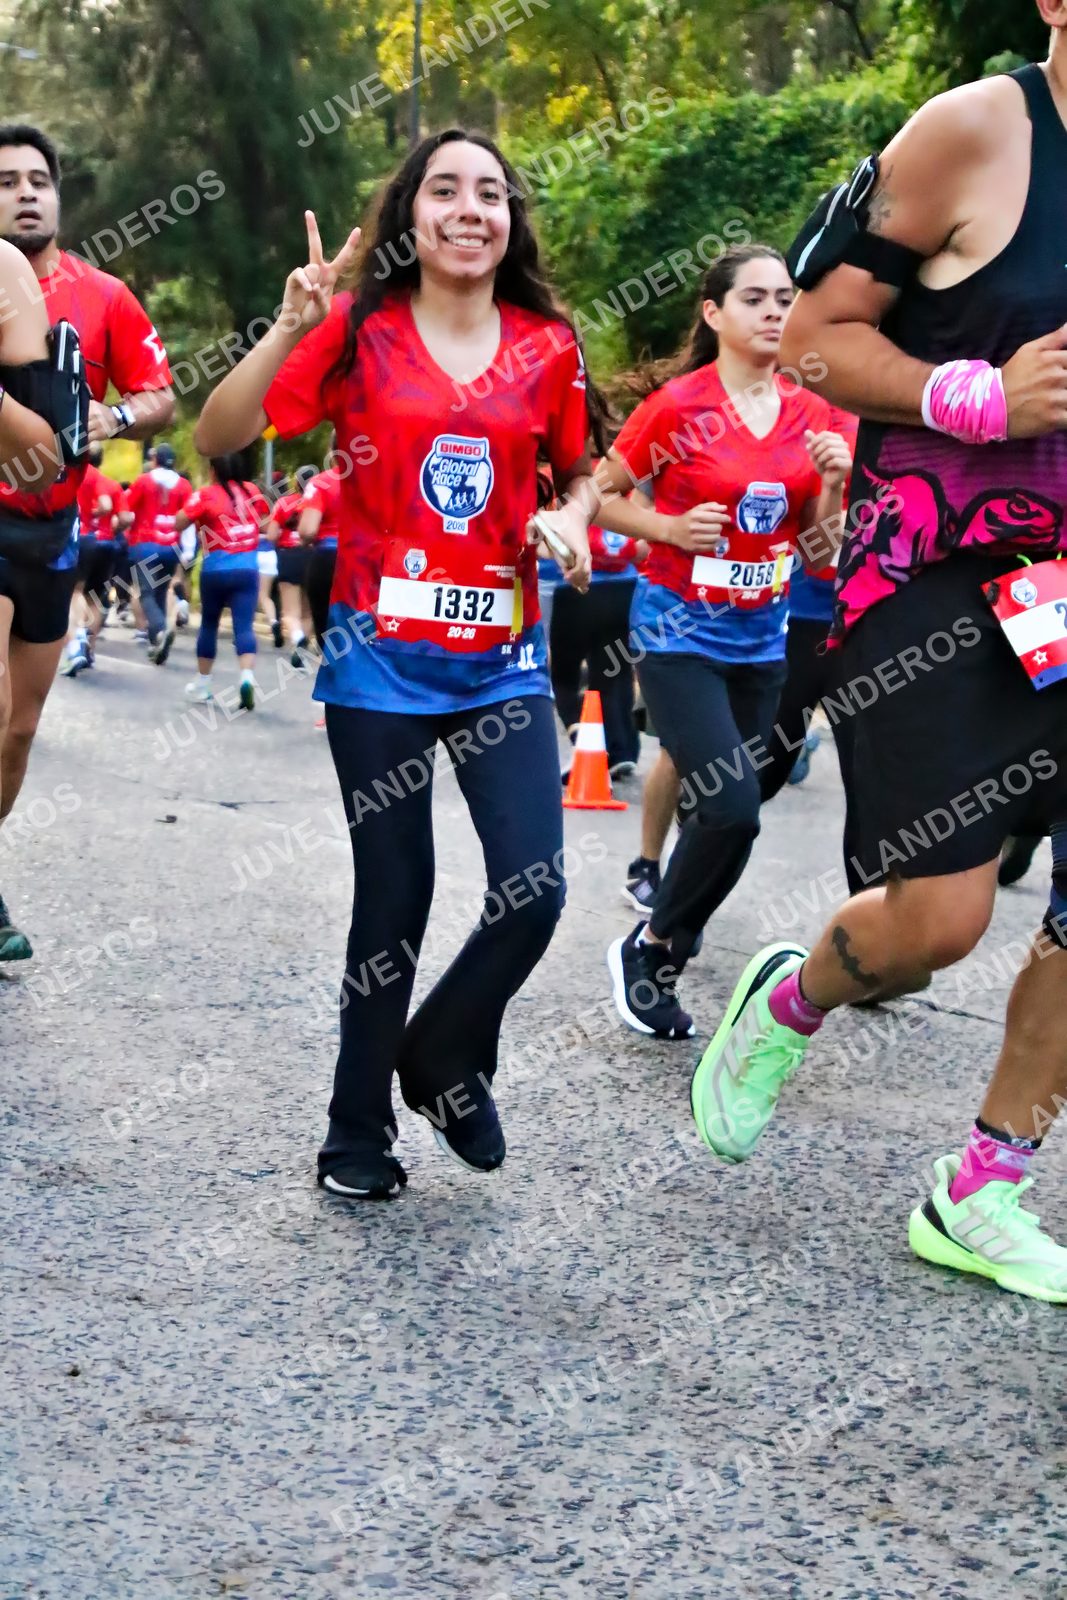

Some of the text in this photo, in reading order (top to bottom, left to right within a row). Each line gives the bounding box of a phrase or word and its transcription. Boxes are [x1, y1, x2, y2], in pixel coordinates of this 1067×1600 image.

[439, 458, 479, 477] Global
[431, 470, 462, 487] Race
[433, 586, 495, 622] 1332
